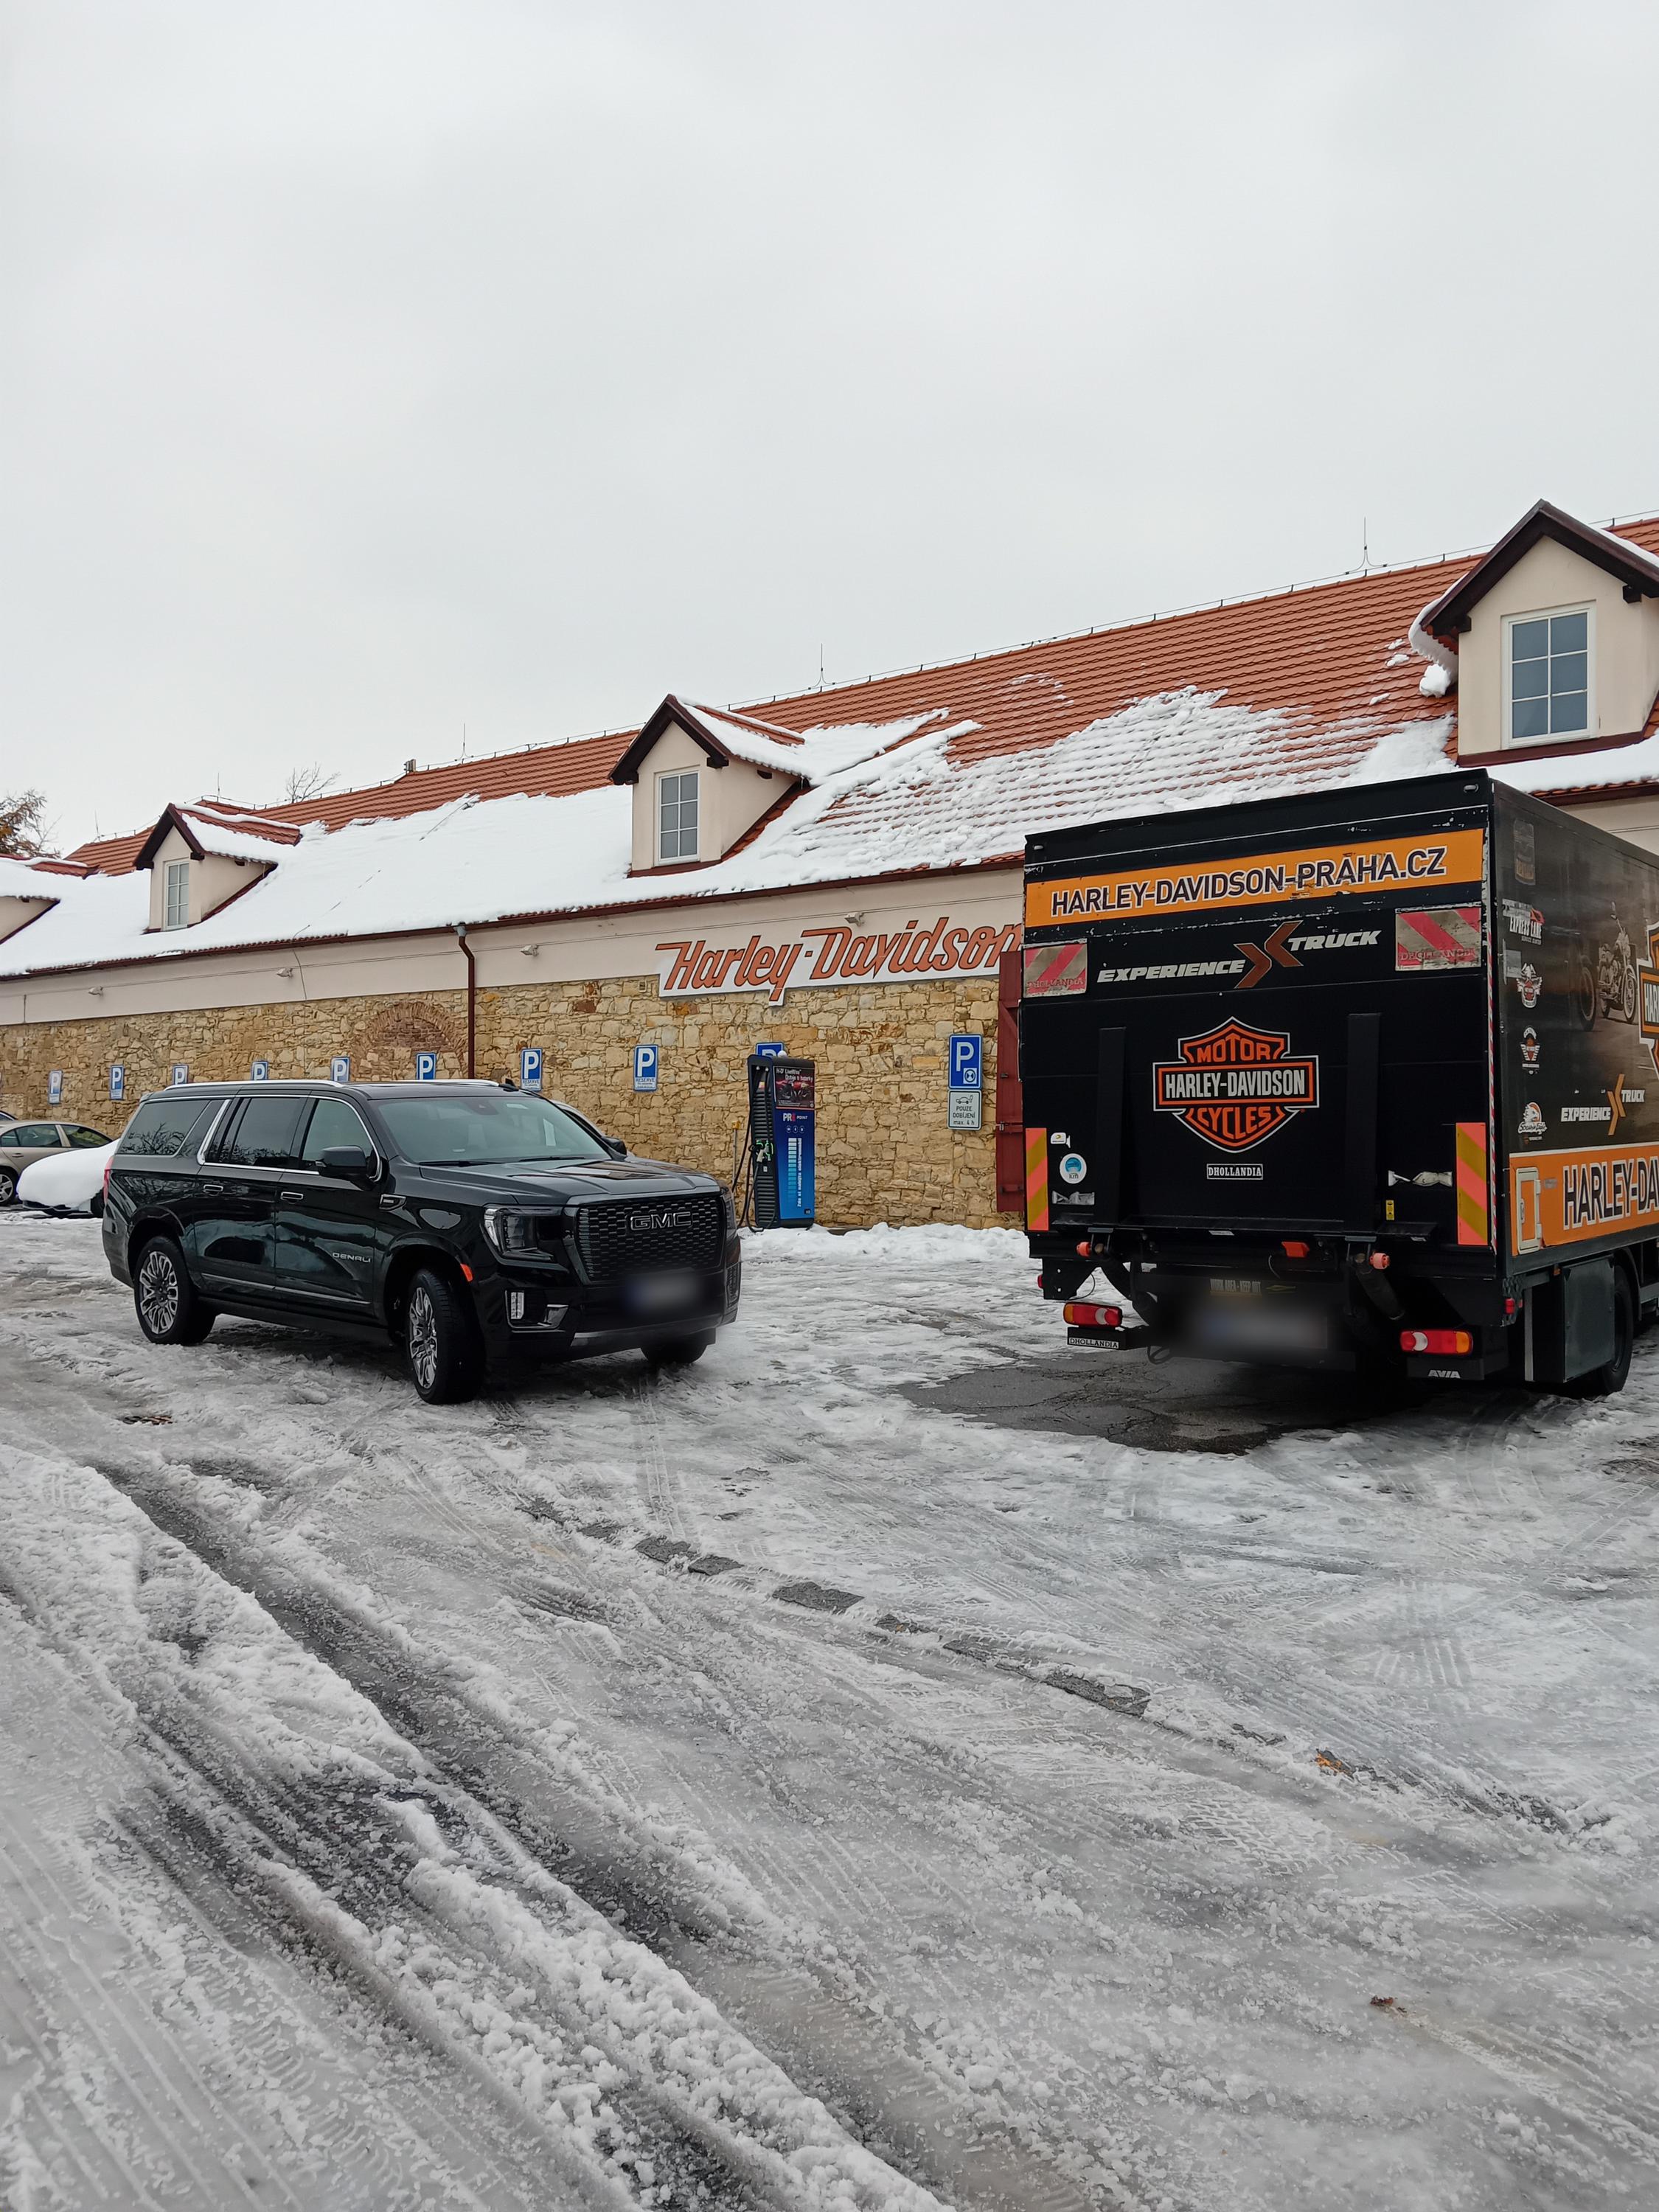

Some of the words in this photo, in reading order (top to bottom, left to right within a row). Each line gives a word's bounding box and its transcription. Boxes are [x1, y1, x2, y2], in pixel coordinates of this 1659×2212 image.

[1051, 845, 1449, 918] HARLEY-DAVIDSON-PRAHA.CZ
[1096, 959, 1246, 983] EXPERIENCE
[1287, 930, 1382, 952] TRUCK
[956, 1042, 974, 1071] P
[1197, 1032, 1271, 1063] MOTOR
[254, 1064, 265, 1080] P
[334, 1060, 347, 1082] P
[420, 1056, 433, 1080] P
[524, 1051, 539, 1079] P
[636, 1048, 655, 1077] P
[50, 1072, 60, 1094] P
[111, 1067, 122, 1091] P
[175, 1067, 185, 1085] P
[1165, 1069, 1305, 1099] HARLEY-DAVIDSON
[1621, 1089, 1646, 1103] TRUCK
[1197, 1106, 1272, 1140] CYCLES
[1560, 1107, 1612, 1122] EXPERIENCE
[1208, 1166, 1262, 1177] DHOLLANDIA
[630, 1211, 692, 1231] GMC
[332, 1252, 371, 1263] DENALI
[1070, 1338, 1118, 1348] DHOLLANDIA
[1428, 1369, 1461, 1379] AVIA
